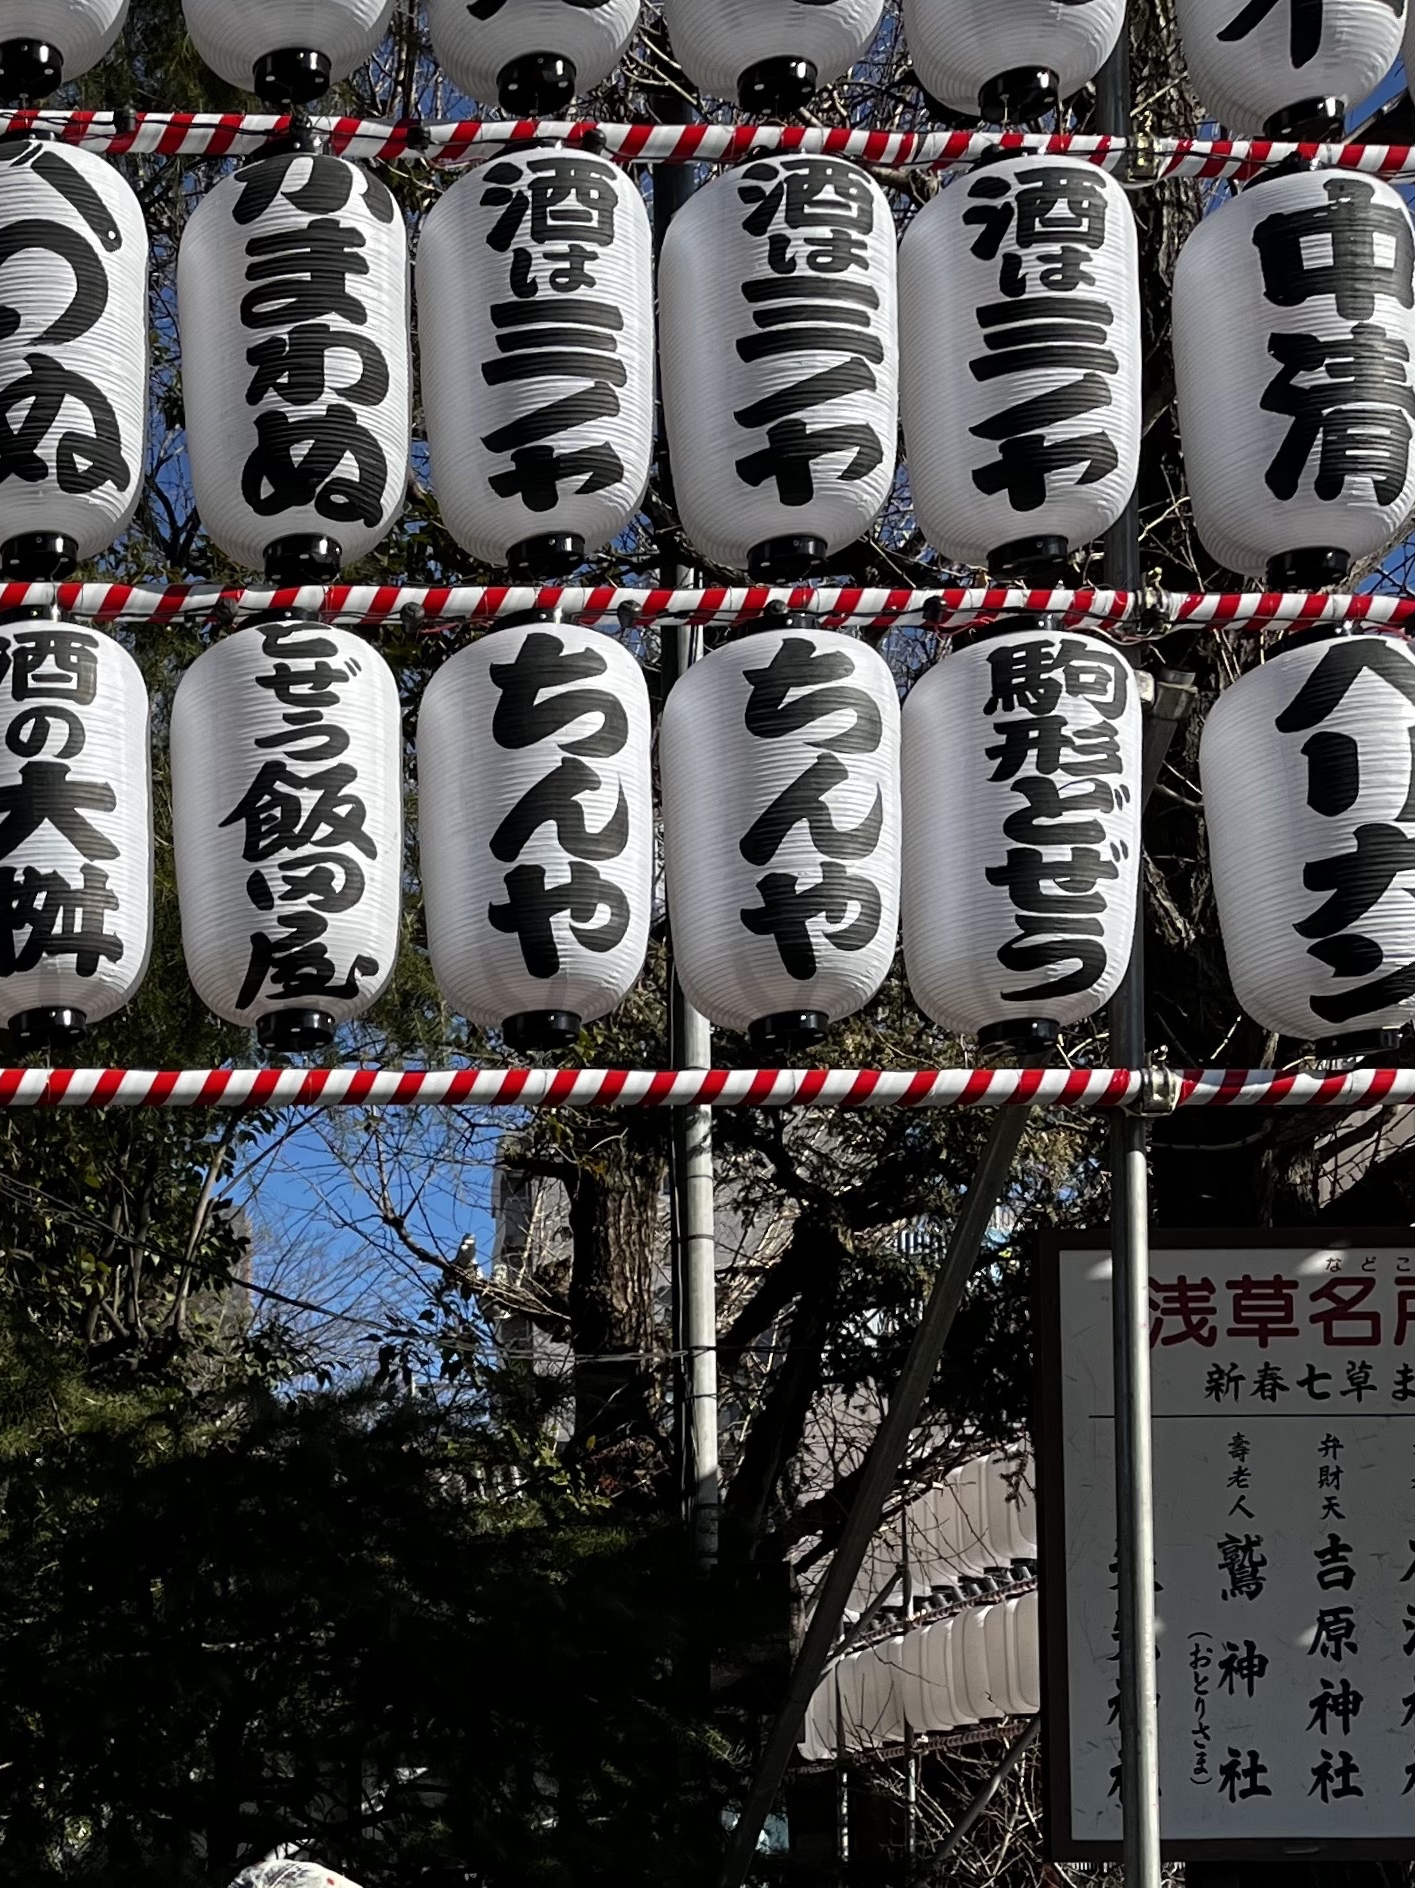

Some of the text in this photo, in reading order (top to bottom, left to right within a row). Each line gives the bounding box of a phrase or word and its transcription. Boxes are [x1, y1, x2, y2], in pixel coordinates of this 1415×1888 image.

[487, 632, 631, 979] ちんや
[738, 637, 884, 981] ちんや
[983, 638, 1131, 1002] 駒形どぜう
[1148, 1273, 1415, 1349] 浅草名
[1317, 1432, 1346, 1521] 弁財天
[1216, 1532, 1273, 1804] 鷲神社
[1305, 1532, 1365, 1804] 吉原神社
